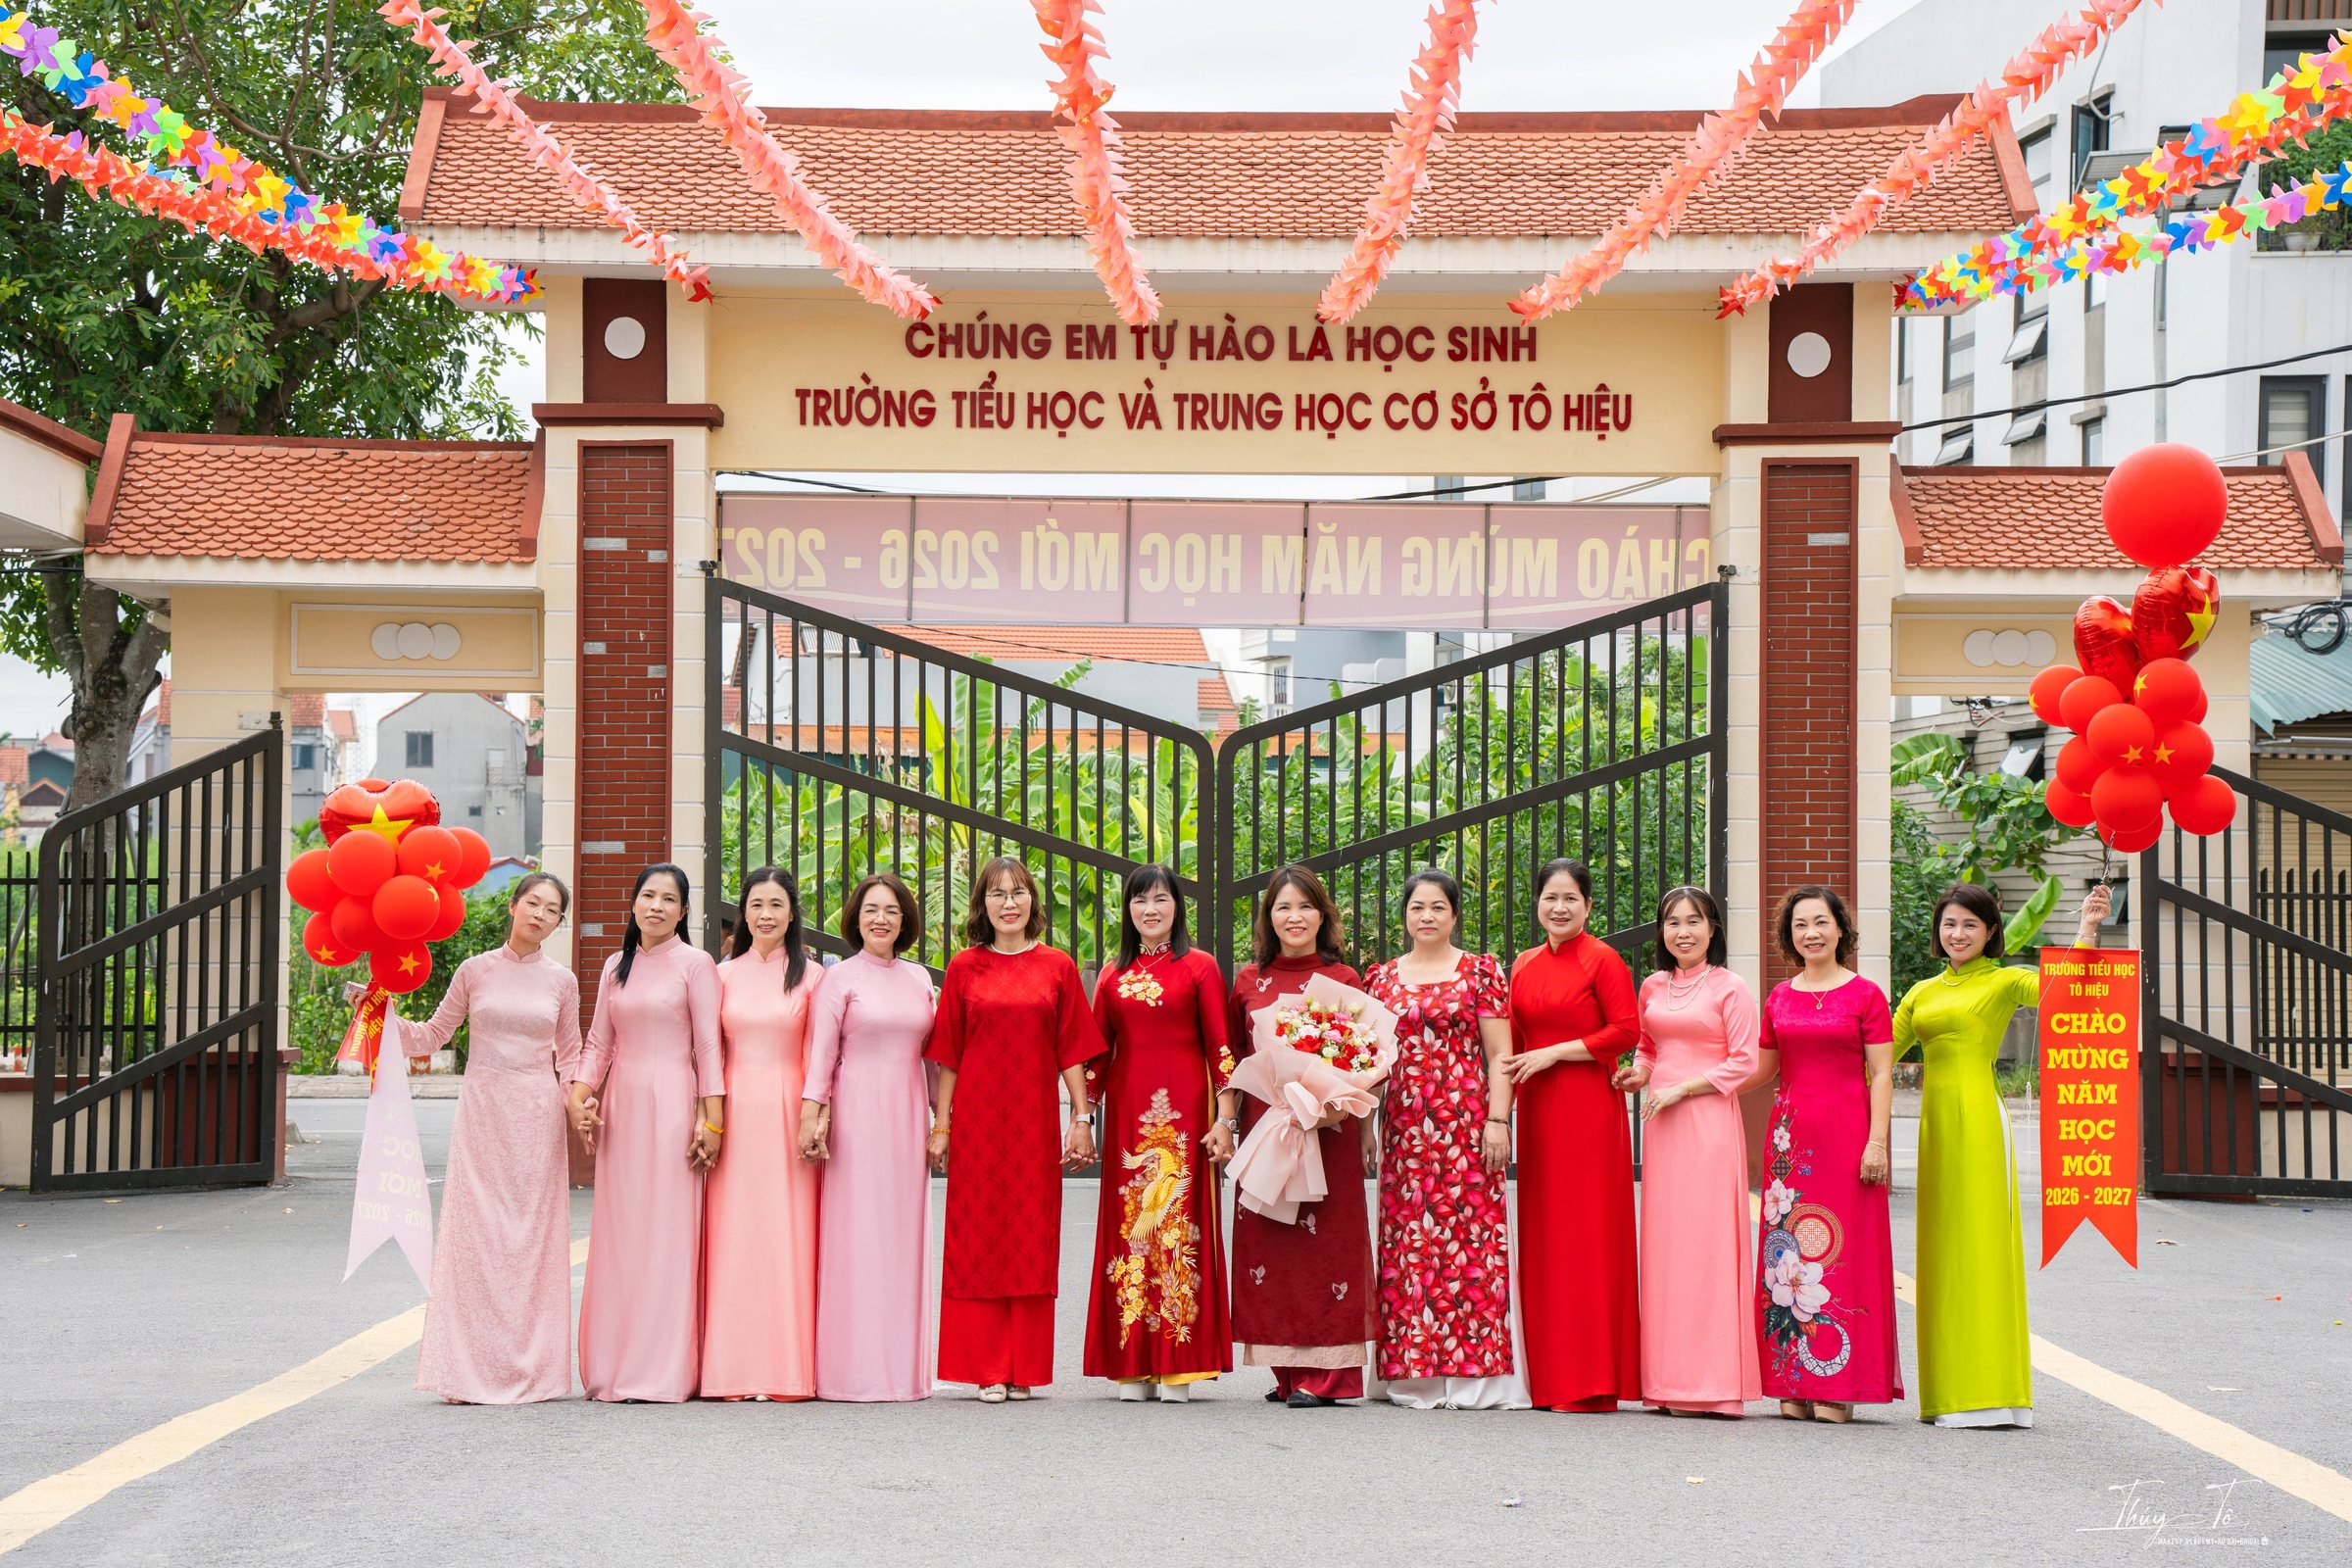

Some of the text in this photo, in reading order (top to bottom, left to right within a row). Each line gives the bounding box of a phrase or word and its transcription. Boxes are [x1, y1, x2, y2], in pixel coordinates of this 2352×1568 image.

[905, 310, 1537, 372] CHÚNG EM TỰ HÀO LÀ HỌC SINH
[795, 370, 1632, 441] TRƯỜNG TIỂU HỌC VÀ TRUNG HỌC CƠ SỞ TÔ HIỆU
[2043, 959, 2135, 979] TRƯỜNG TIỂU HỌC
[2069, 982, 2109, 1000] TÔ HIỆU
[2050, 1007, 2127, 1035] CHÀO
[2047, 1043, 2130, 1070] MỪNG
[2057, 1079, 2118, 1104] NĂM
[2059, 1119, 2116, 1145] HỌC
[2062, 1150, 2112, 1177] MỚI
[2045, 1188, 2080, 1206] 2026
[2093, 1187, 2132, 1206] 2027
